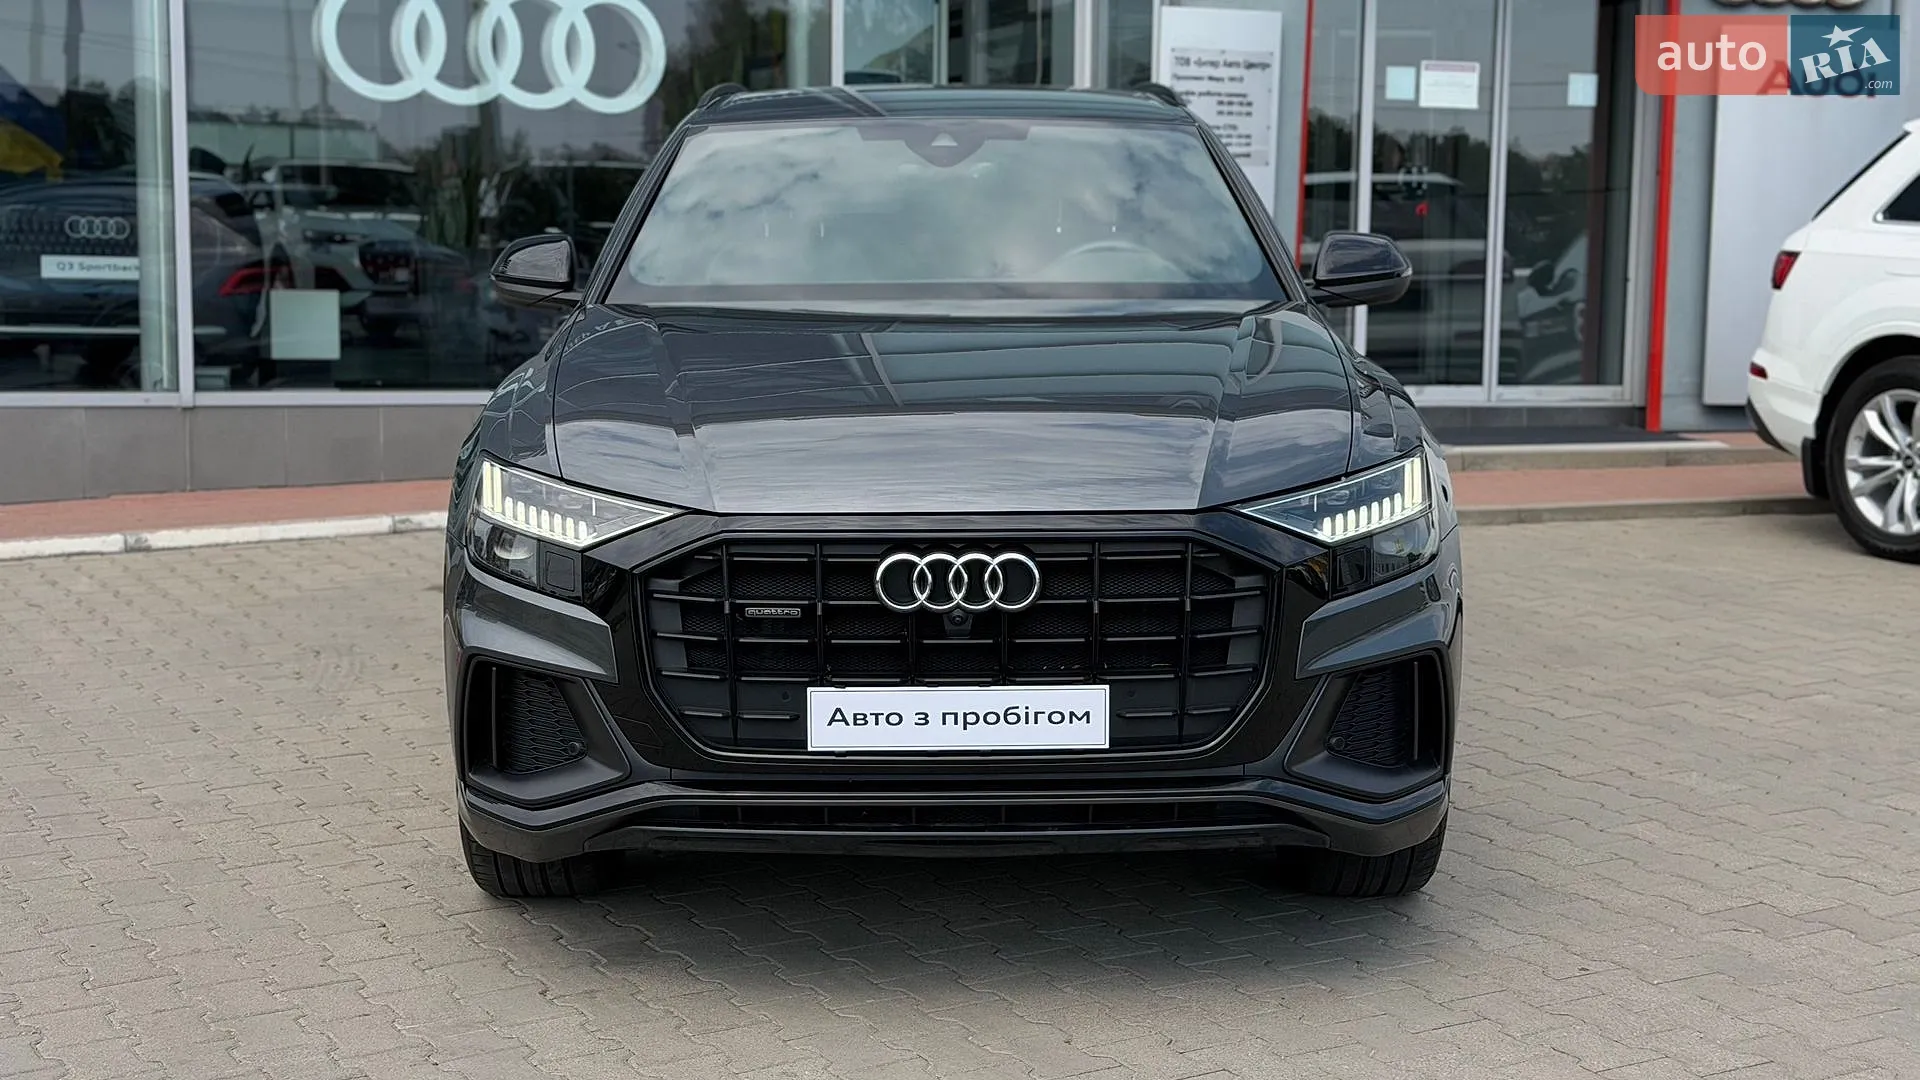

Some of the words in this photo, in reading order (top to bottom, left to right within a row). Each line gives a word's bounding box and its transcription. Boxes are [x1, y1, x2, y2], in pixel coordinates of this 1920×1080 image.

[56, 262, 74, 272] Q3
[747, 608, 799, 617] quattro
[827, 707, 904, 727] Авто
[914, 711, 930, 727] з
[941, 706, 1091, 731] пробігом
